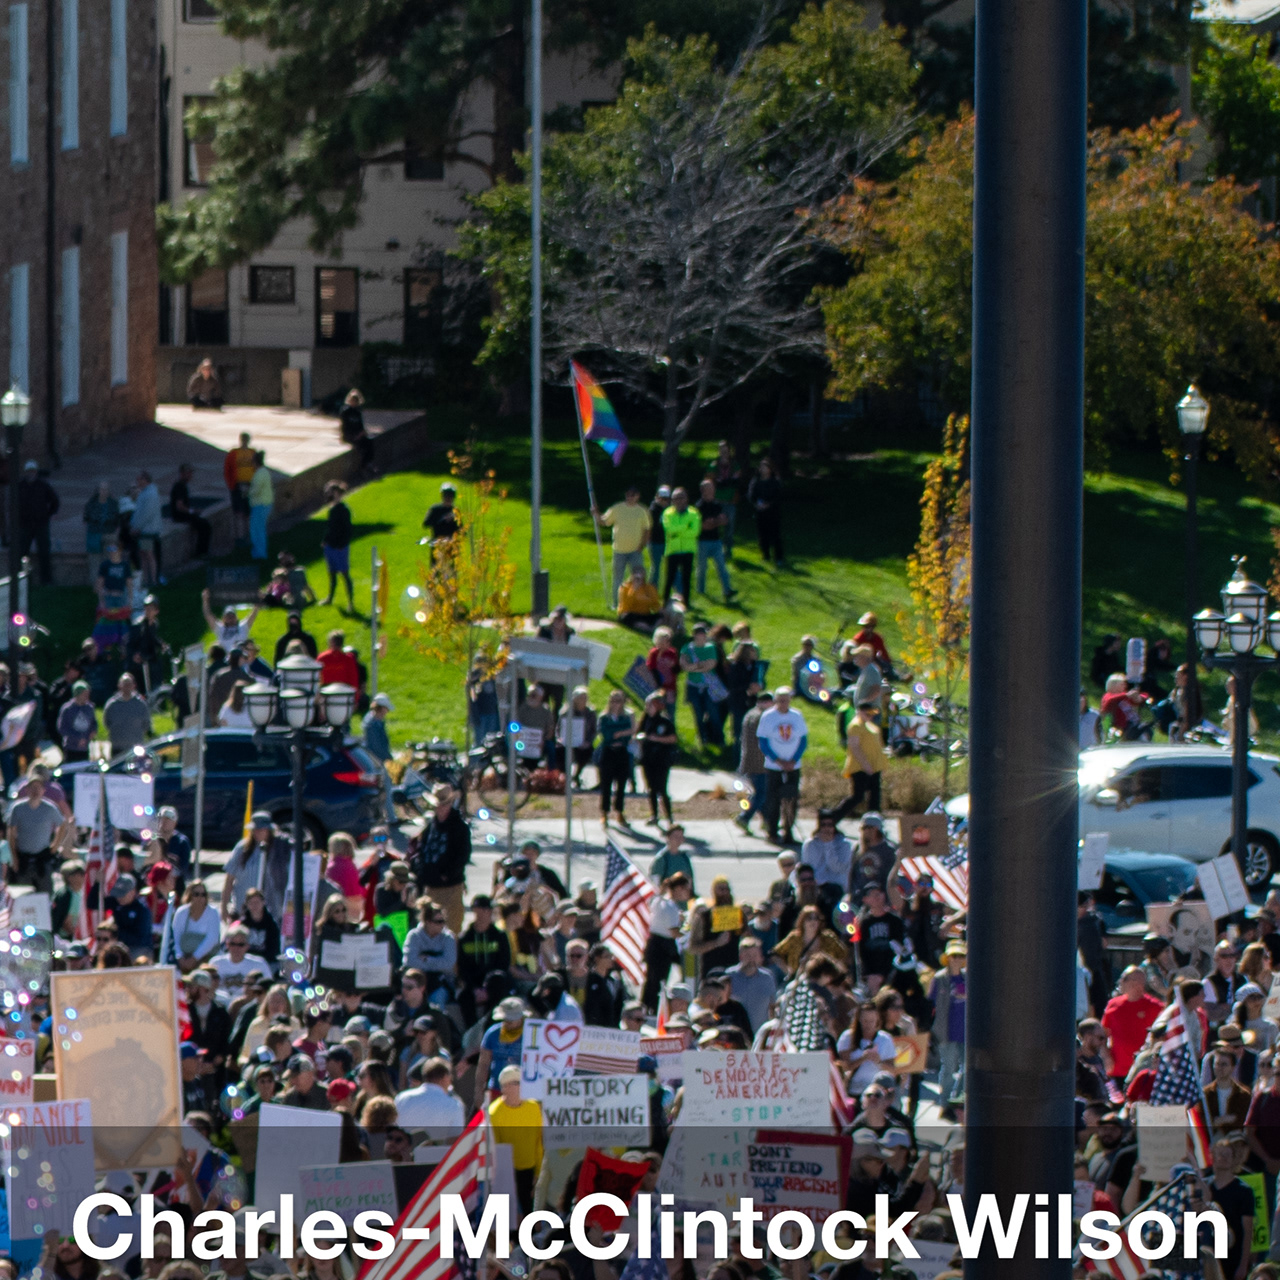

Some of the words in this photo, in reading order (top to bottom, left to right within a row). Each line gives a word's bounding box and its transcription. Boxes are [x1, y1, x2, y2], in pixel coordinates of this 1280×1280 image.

[726, 1053, 781, 1069] SAVE
[547, 1079, 633, 1097] HISTORY
[544, 1106, 644, 1126] WATCHING
[731, 1105, 783, 1121] STOP
[748, 1158, 822, 1176] PRETEND
